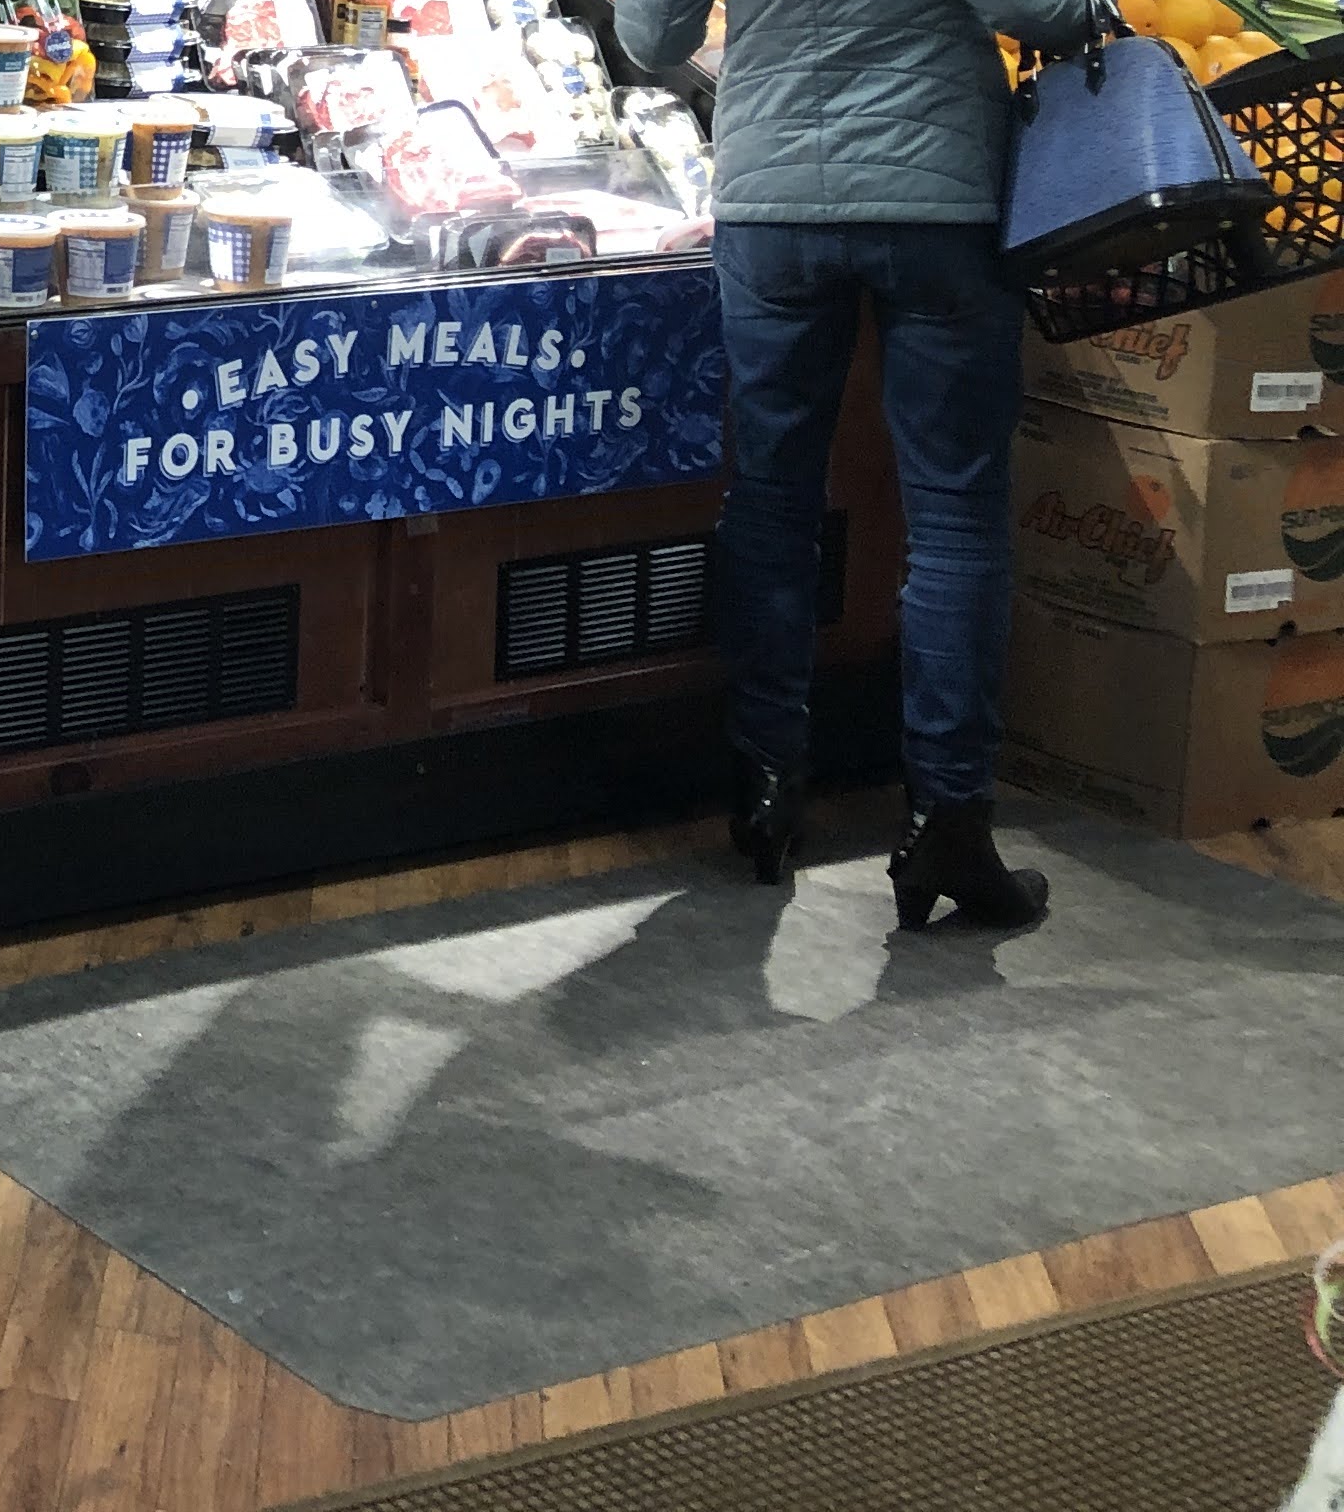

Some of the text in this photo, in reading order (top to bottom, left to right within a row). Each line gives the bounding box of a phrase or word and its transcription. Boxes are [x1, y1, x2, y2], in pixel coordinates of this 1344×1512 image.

[217, 330, 359, 410] EASY
[122, 387, 644, 486] FOR BUSY NIGHTS
